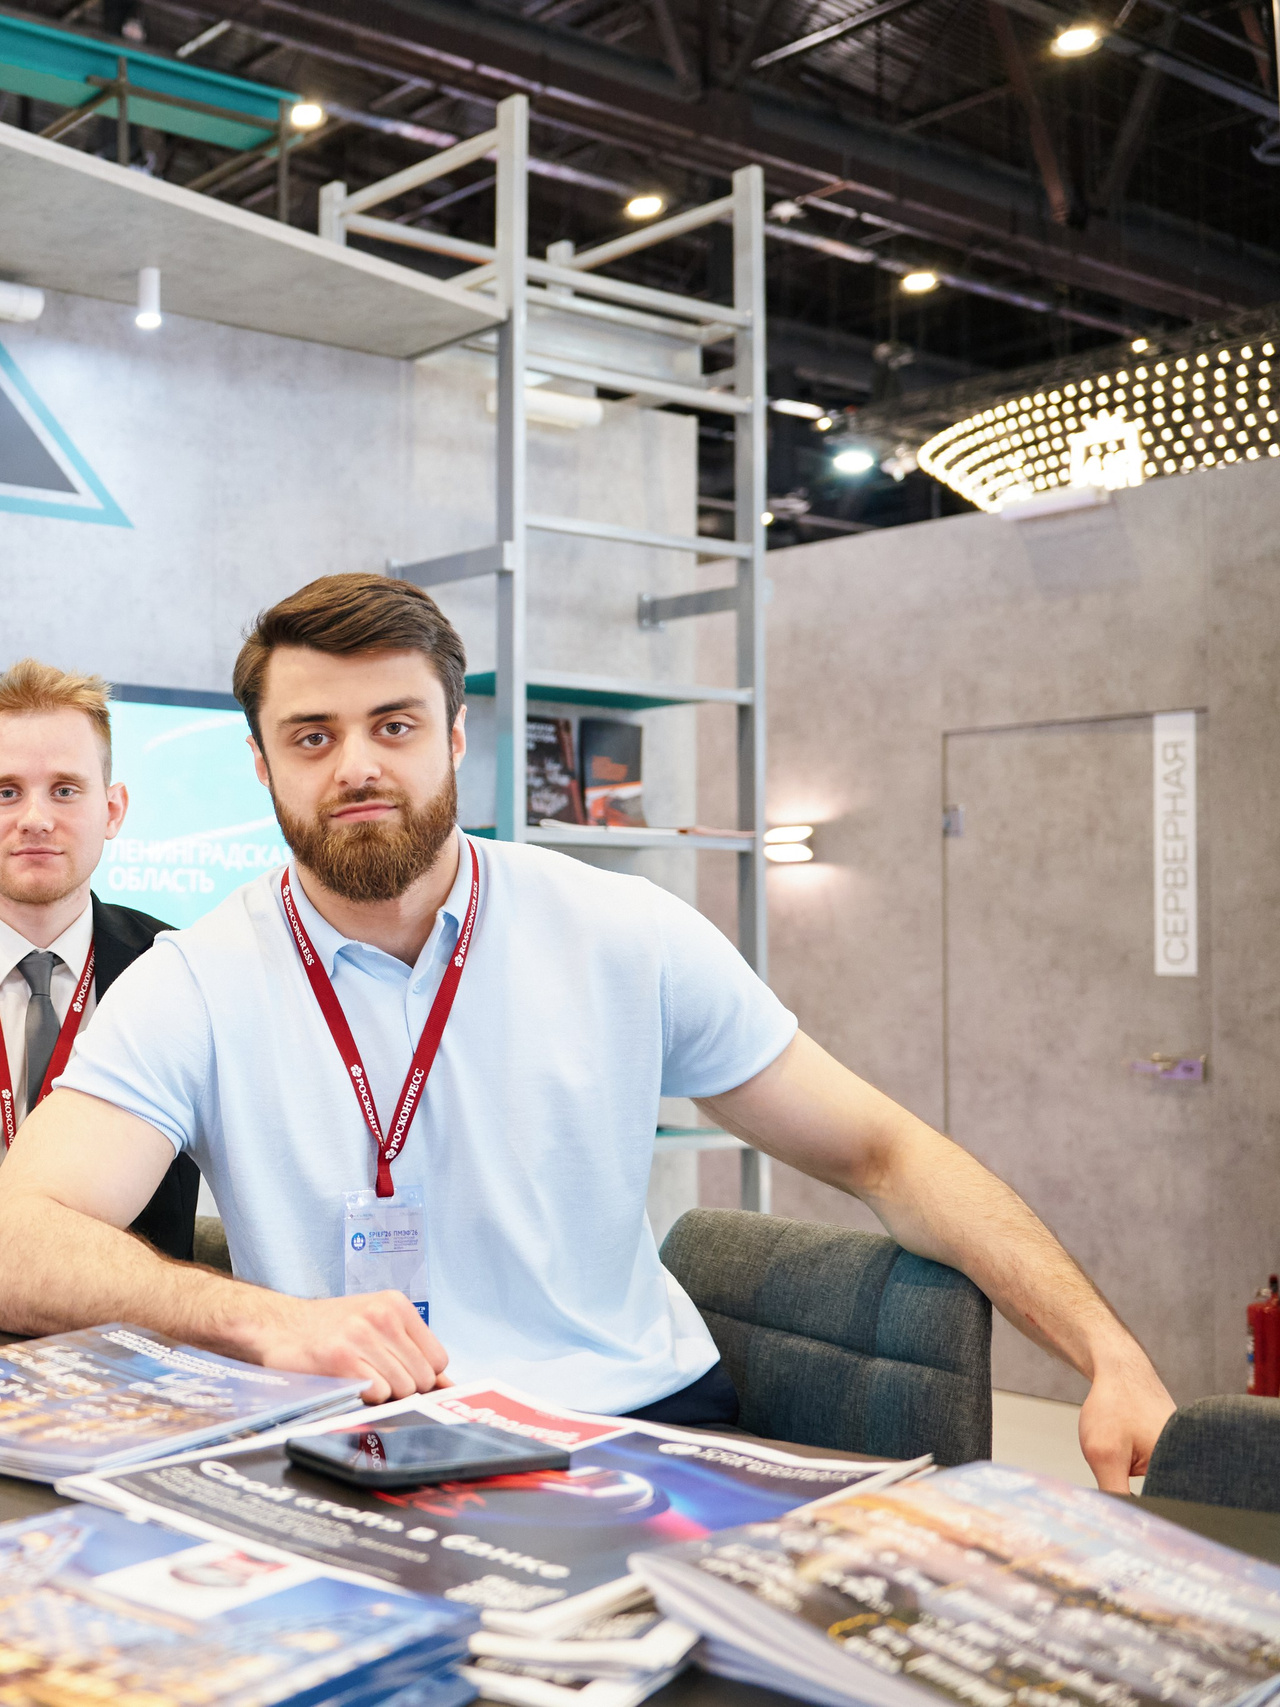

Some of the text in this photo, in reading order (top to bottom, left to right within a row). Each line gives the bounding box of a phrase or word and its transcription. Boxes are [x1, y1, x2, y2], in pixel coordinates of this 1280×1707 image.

[108, 866, 215, 893] ОБЛАСТЬ
[1162, 740, 1190, 966] СЕРВЕРНАЯ
[284, 895, 315, 966] ROSCONGRESS
[459, 881, 479, 955] ROSCONGRESS
[390, 1068, 425, 1149] РОСКОНГРЕСС
[199, 1460, 298, 1502] Свой
[440, 1534, 571, 1580] банке
